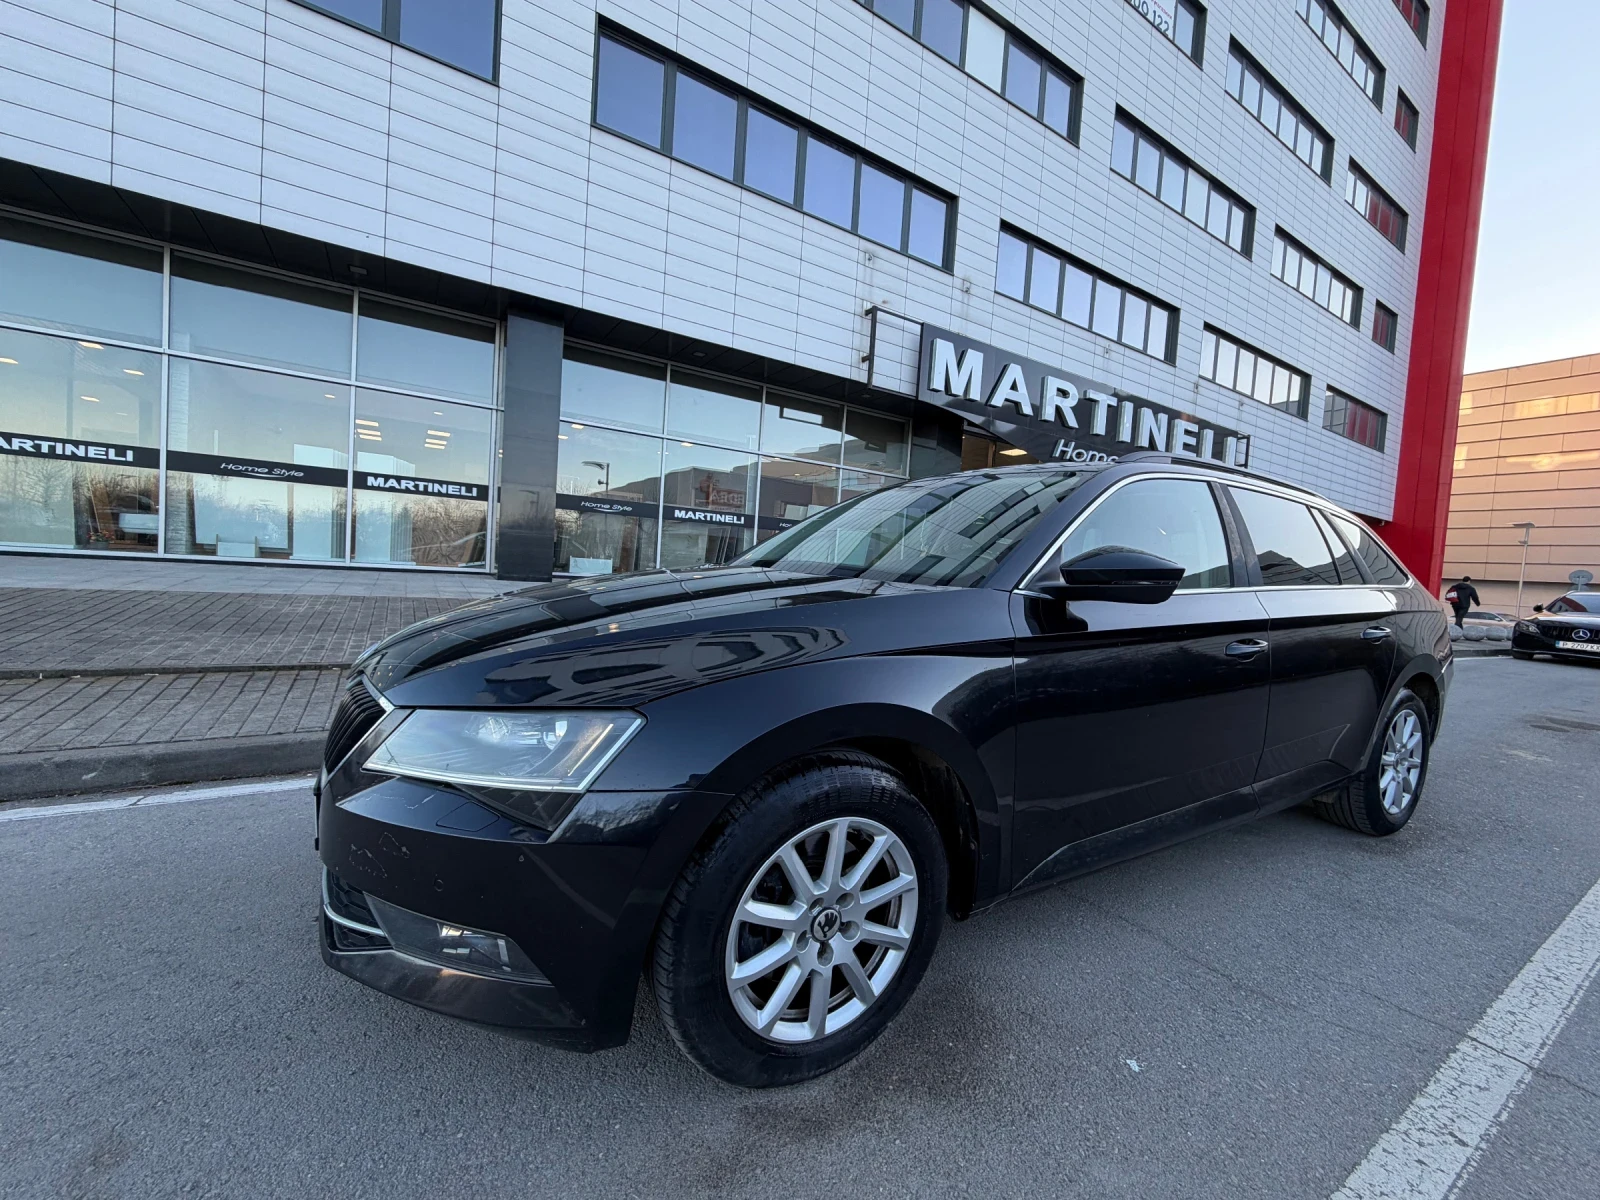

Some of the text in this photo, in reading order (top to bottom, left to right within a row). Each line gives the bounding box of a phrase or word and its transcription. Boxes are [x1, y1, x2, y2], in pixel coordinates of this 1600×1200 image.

[927, 338, 1238, 467] MARTINELI
[220, 462, 304, 478] Home Style
[367, 476, 478, 497] MARTINELI
[580, 501, 611, 509] Home
[674, 509, 745, 525] MARTINELI
